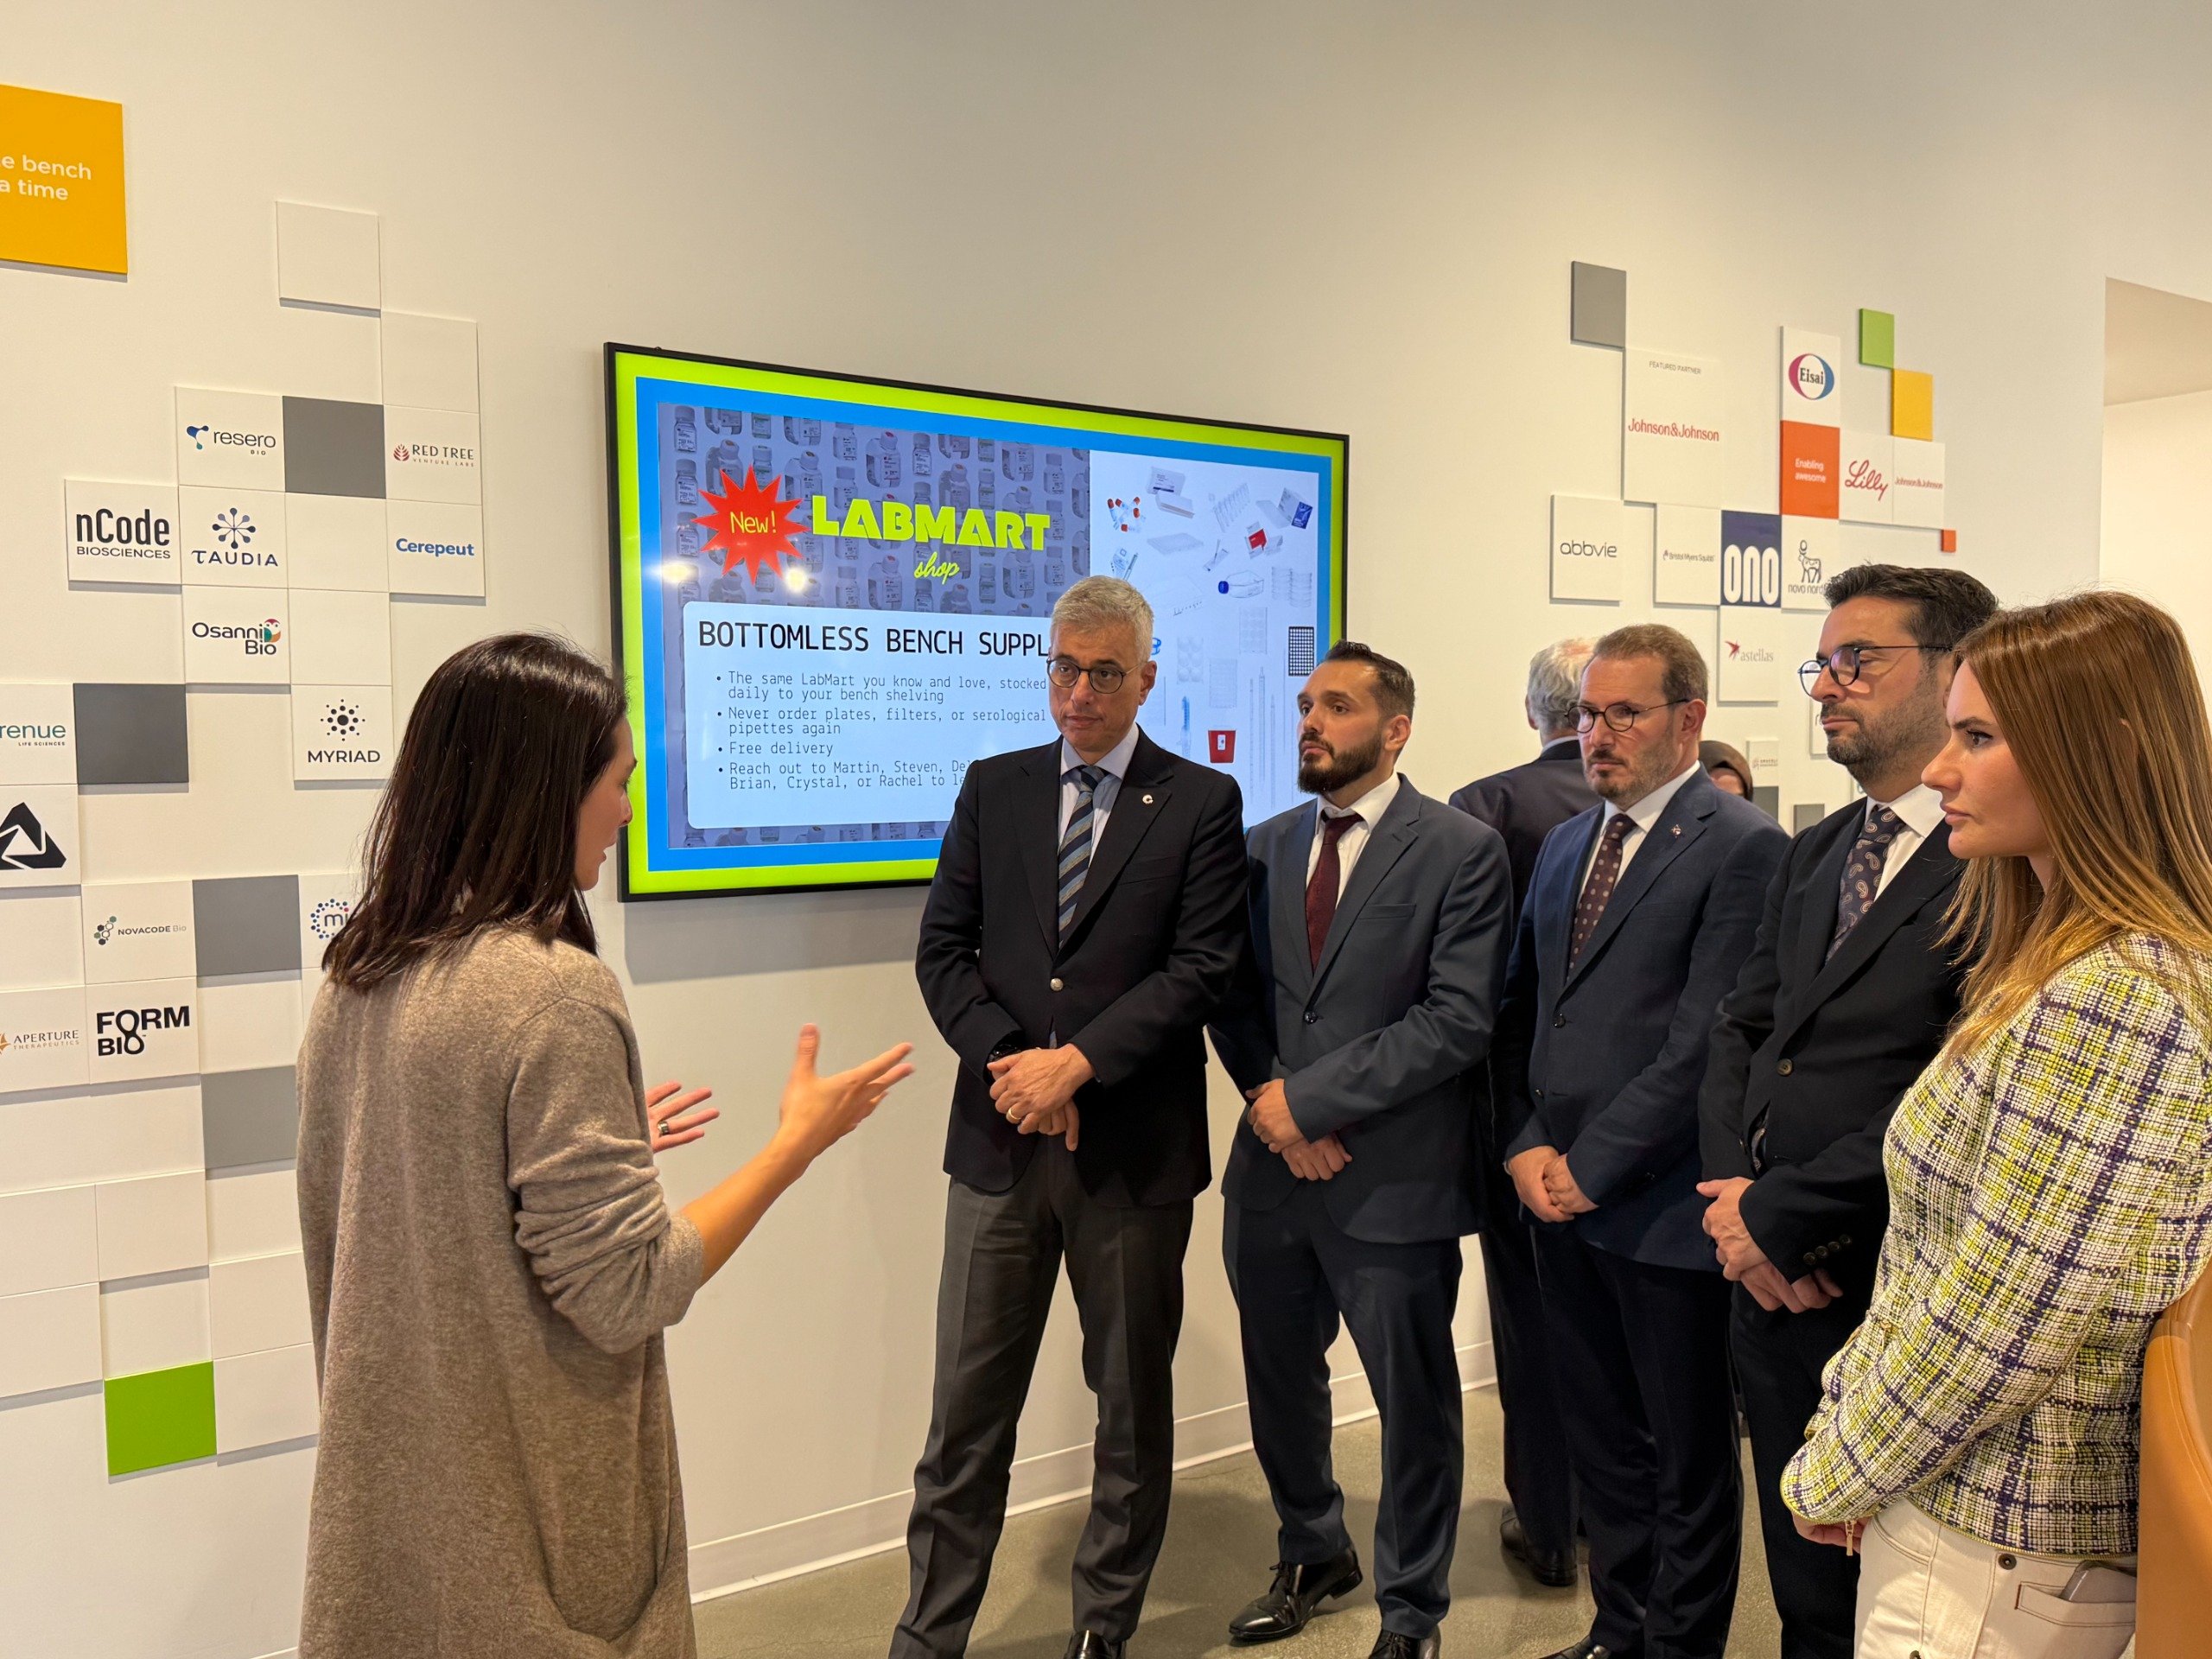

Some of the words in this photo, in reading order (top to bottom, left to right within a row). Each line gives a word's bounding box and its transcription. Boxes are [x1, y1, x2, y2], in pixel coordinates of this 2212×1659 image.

[0, 156, 15, 169] e
[22, 154, 92, 180] bench
[17, 179, 68, 200] time
[1649, 360, 1676, 372] FEATURED
[1799, 366, 1825, 386] Eisai
[1628, 417, 1719, 442] Johnson&Johnson
[213, 430, 276, 448] resero
[412, 444, 439, 457] RED
[442, 447, 474, 461] TREE
[1795, 458, 1825, 472] Enabling
[1795, 472, 1827, 484] awesome
[1845, 459, 1889, 502] Lilly
[76, 508, 170, 546] nCode
[729, 510, 777, 534] New!
[811, 494, 1051, 551] LABMART
[77, 546, 171, 559] BIOSCIENCES
[396, 537, 475, 557] Cerepeut
[1560, 540, 1618, 559] abbvie
[913, 551, 960, 585] shop
[1789, 584, 1806, 594] novo
[1807, 584, 1824, 594] nord
[192, 620, 264, 639] Osanni
[698, 620, 870, 652] BOTTOMLESS
[886, 628, 963, 655] BENCH
[979, 632, 1049, 657] SUPPL
[245, 639, 277, 655] Bio
[1740, 647, 1774, 663] astellas
[728, 671, 753, 684] The
[761, 674, 793, 685] same
[801, 672, 855, 687] LabMart
[862, 677, 886, 690] you
[893, 675, 923, 688] know
[929, 676, 951, 688] and
[958, 676, 991, 690] love,
[1000, 677, 1046, 690] stocked
[728, 686, 769, 701] daily
[778, 687, 793, 700] to
[801, 690, 833, 703] your
[840, 687, 879, 702] bench
[886, 689, 944, 704] shelving
[728, 706, 770, 720] Never
[778, 707, 817, 721] order
[825, 708, 876, 723] plates,
[887, 708, 942, 723] filters,
[950, 711, 965, 721] or
[972, 708, 1046, 724] serological
[728, 721, 794, 737] pipettes
[802, 722, 841, 738] again
[307, 749, 381, 763] MYRIAD
[729, 741, 762, 754] Free
[770, 741, 834, 759] delivery
[729, 761, 771, 776] Reach
[779, 762, 802, 775] out
[811, 762, 826, 774] to
[833, 760, 886, 775] Martin,
[893, 760, 944, 775] Steven,
[729, 776, 777, 791] Brian,
[786, 774, 848, 791] Crystal,
[856, 778, 872, 788] or
[879, 772, 923, 787] Rachel
[931, 775, 945, 785] to
[953, 773, 965, 785] le
[118, 925, 171, 936] NOVACODE
[96, 1005, 190, 1036] FORM
[13, 1039, 80, 1051] THERAPEUTICS
[14, 1029, 79, 1044] APERTURE
[98, 1036, 145, 1056] BIO
